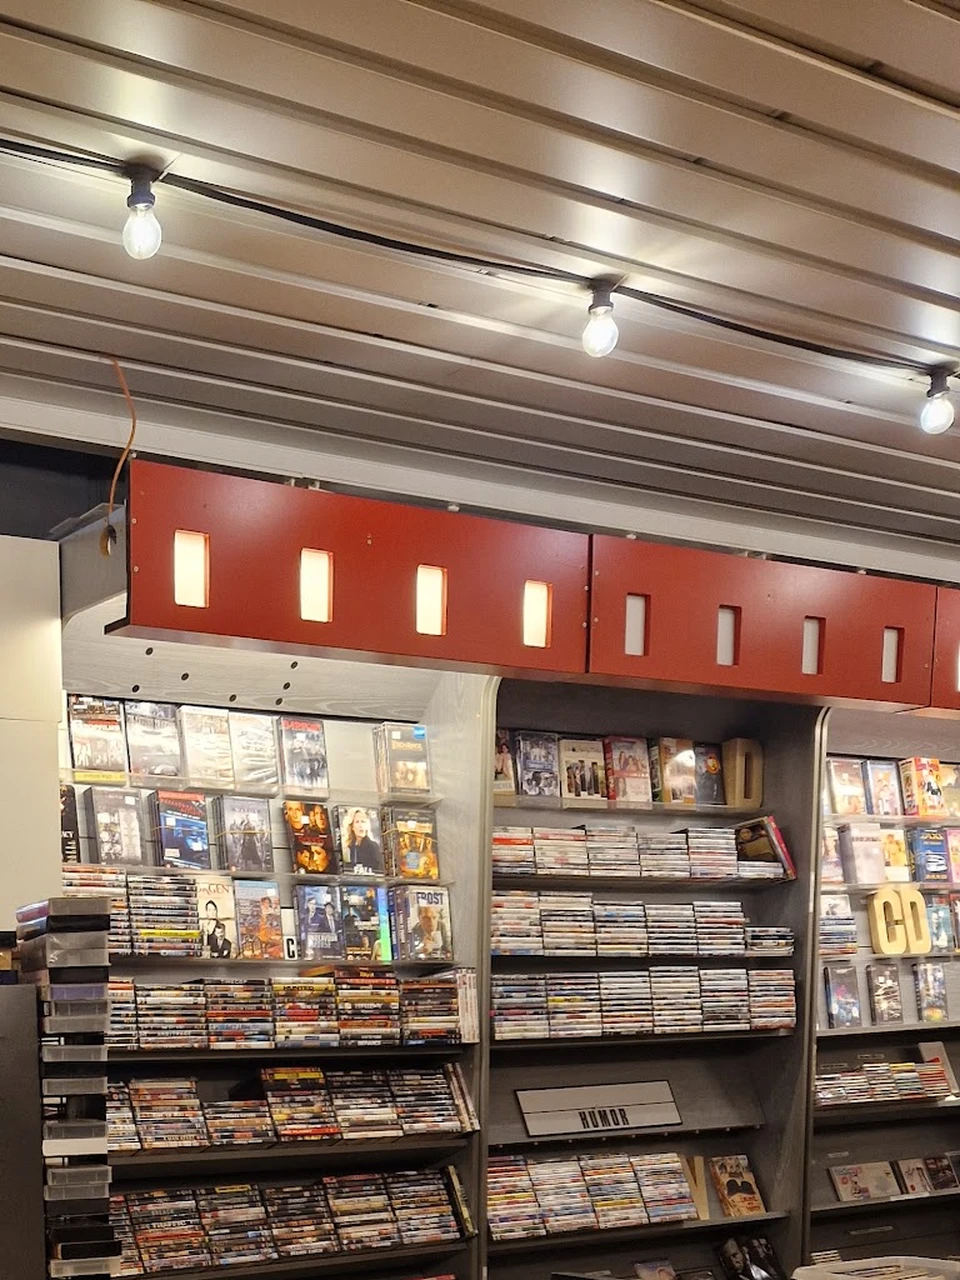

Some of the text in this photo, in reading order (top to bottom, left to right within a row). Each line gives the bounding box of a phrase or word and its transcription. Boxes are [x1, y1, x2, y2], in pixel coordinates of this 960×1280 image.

[415, 891, 444, 905] FROST
[869, 890, 931, 955] CD
[578, 1108, 629, 1129] HUMOR
